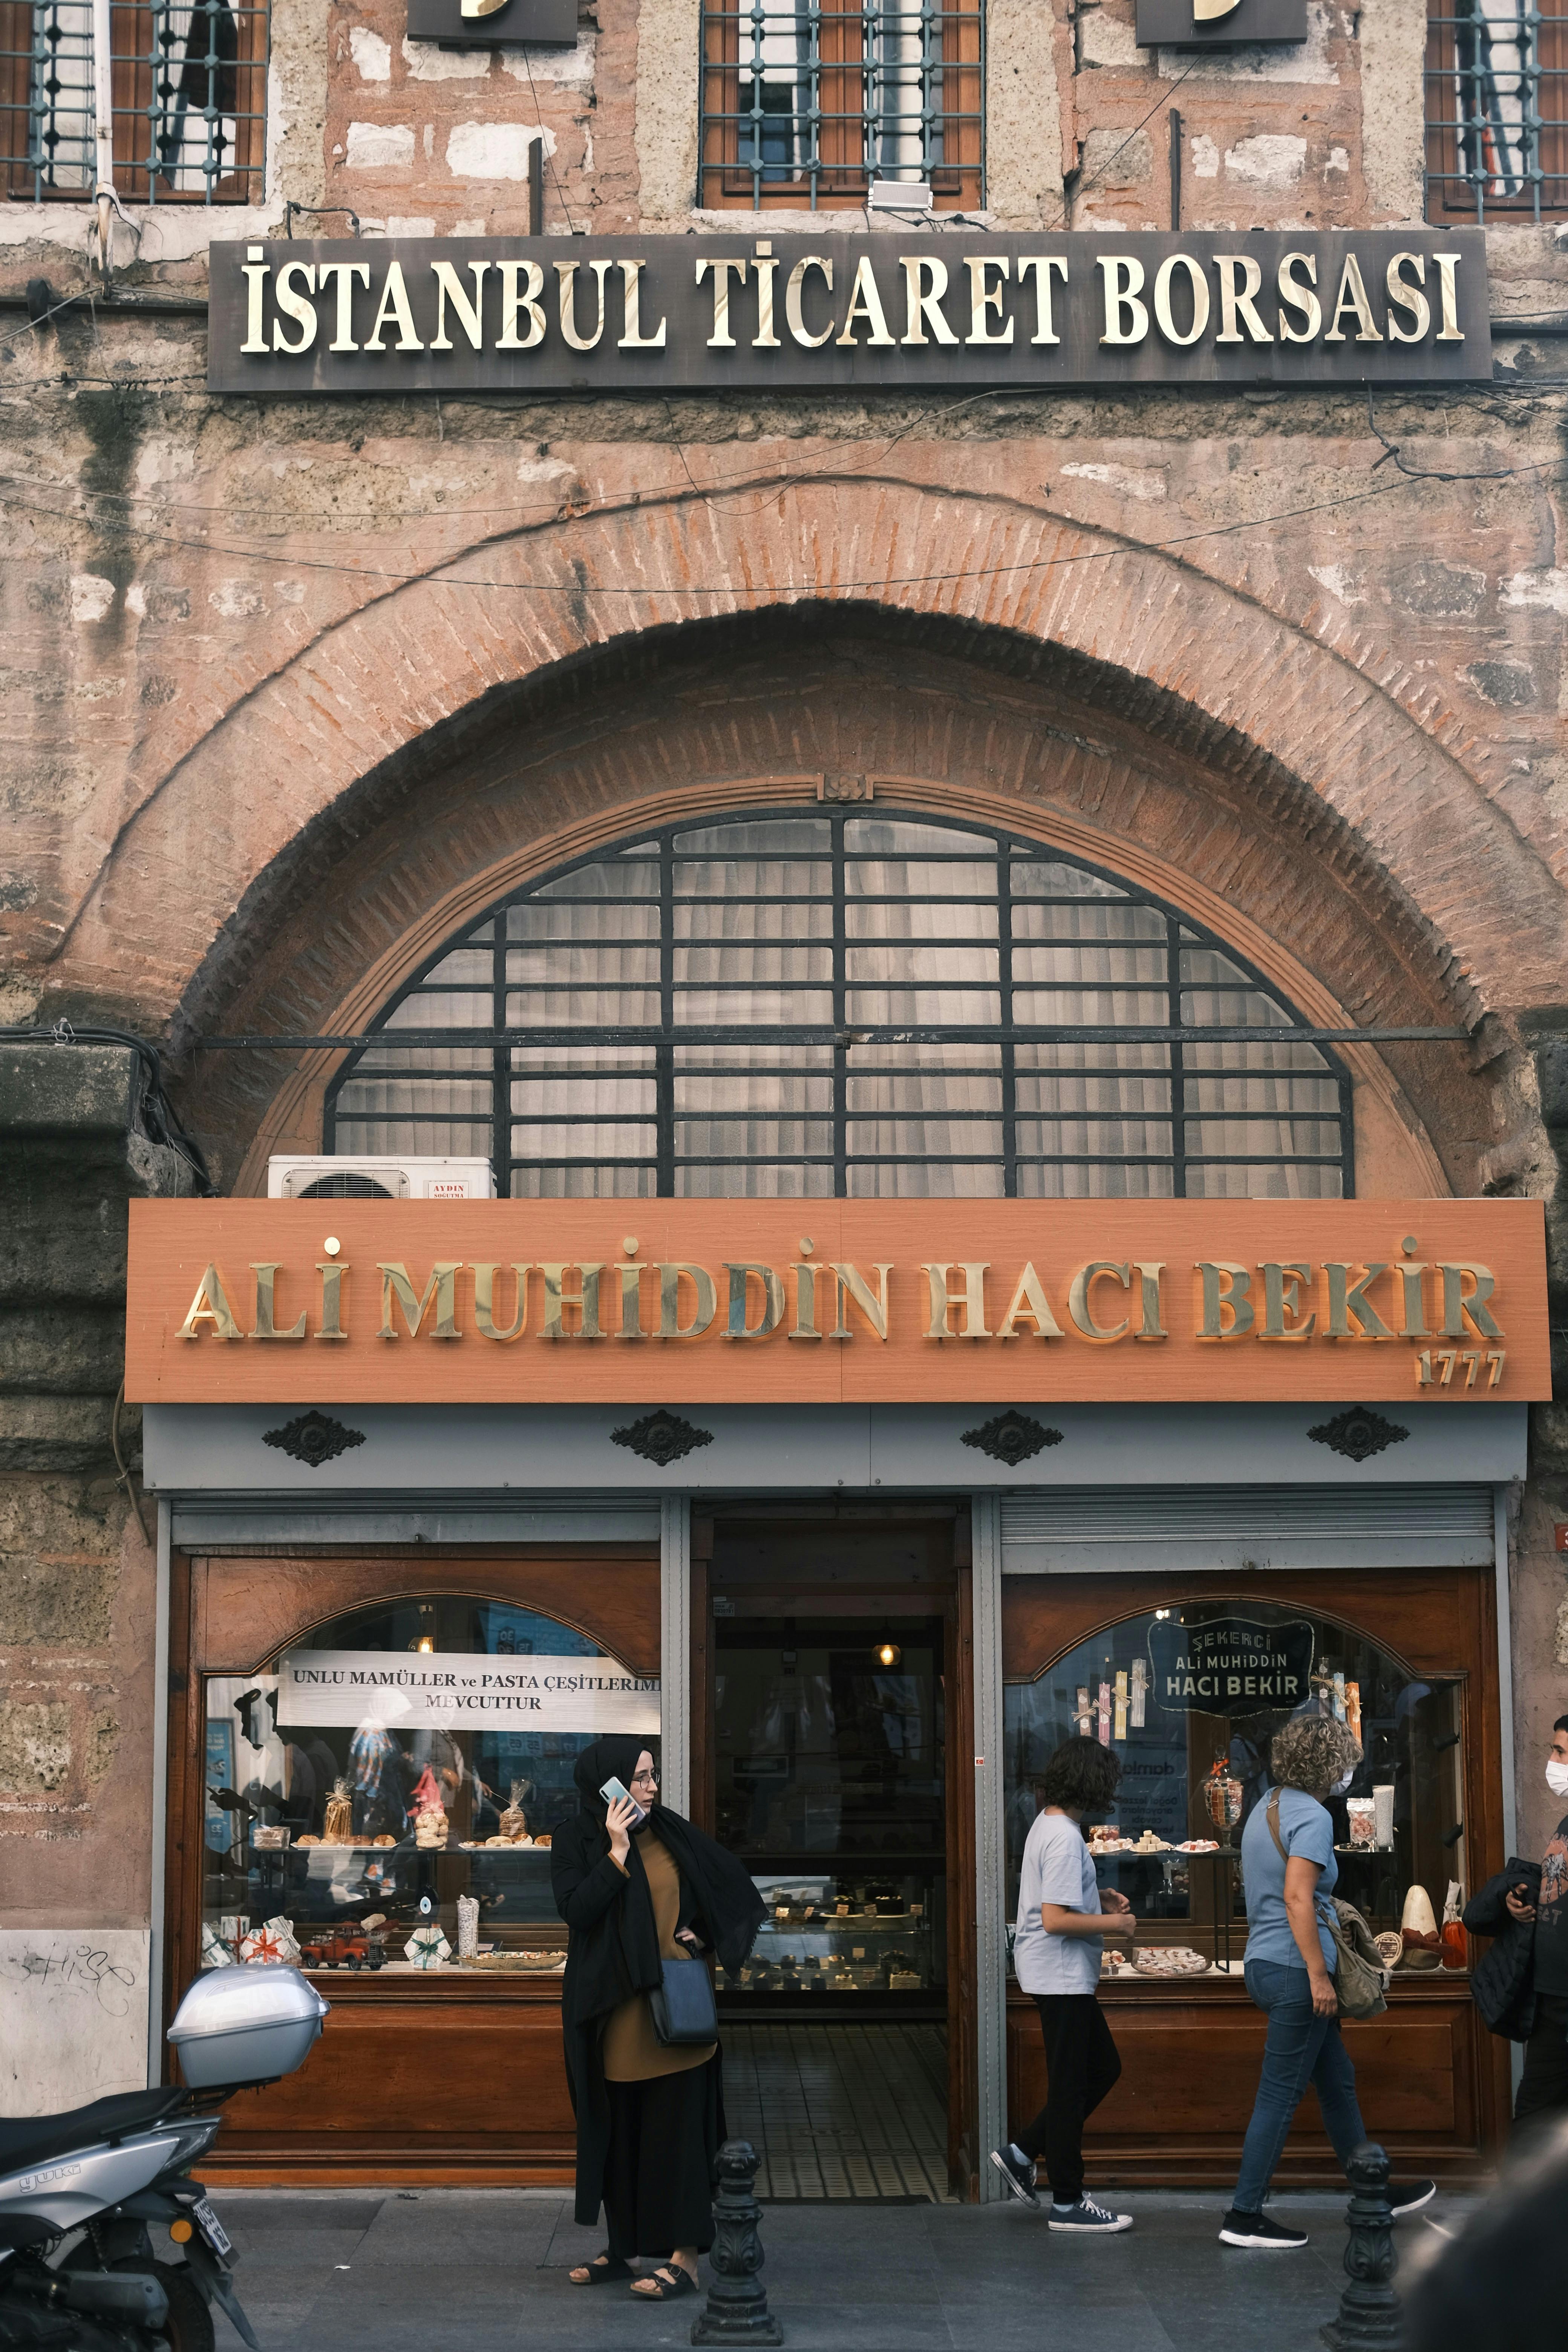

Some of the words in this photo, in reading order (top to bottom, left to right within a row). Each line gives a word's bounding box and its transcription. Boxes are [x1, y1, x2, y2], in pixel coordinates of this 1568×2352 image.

[240, 246, 666, 354] İSTANBUL
[695, 240, 1068, 348] TİCARET
[1096, 253, 1462, 346] BORSASI
[175, 1237, 350, 1338] ALİ
[376, 1236, 894, 1340] MUHİDDİN
[920, 1261, 1167, 1339] HACI
[1193, 1236, 1505, 1339] BEKİR
[1416, 1350, 1506, 1386] 1777
[293, 1670, 345, 1685] UNLU
[349, 1669, 457, 1687] MAMÜLLER
[461, 1678, 477, 1687] ve
[481, 1674, 540, 1689] PASTA
[1167, 1675, 1219, 1696] HACI
[1227, 1670, 1298, 1696] BEKİR
[425, 1694, 542, 1710] MEVCUTTUR
